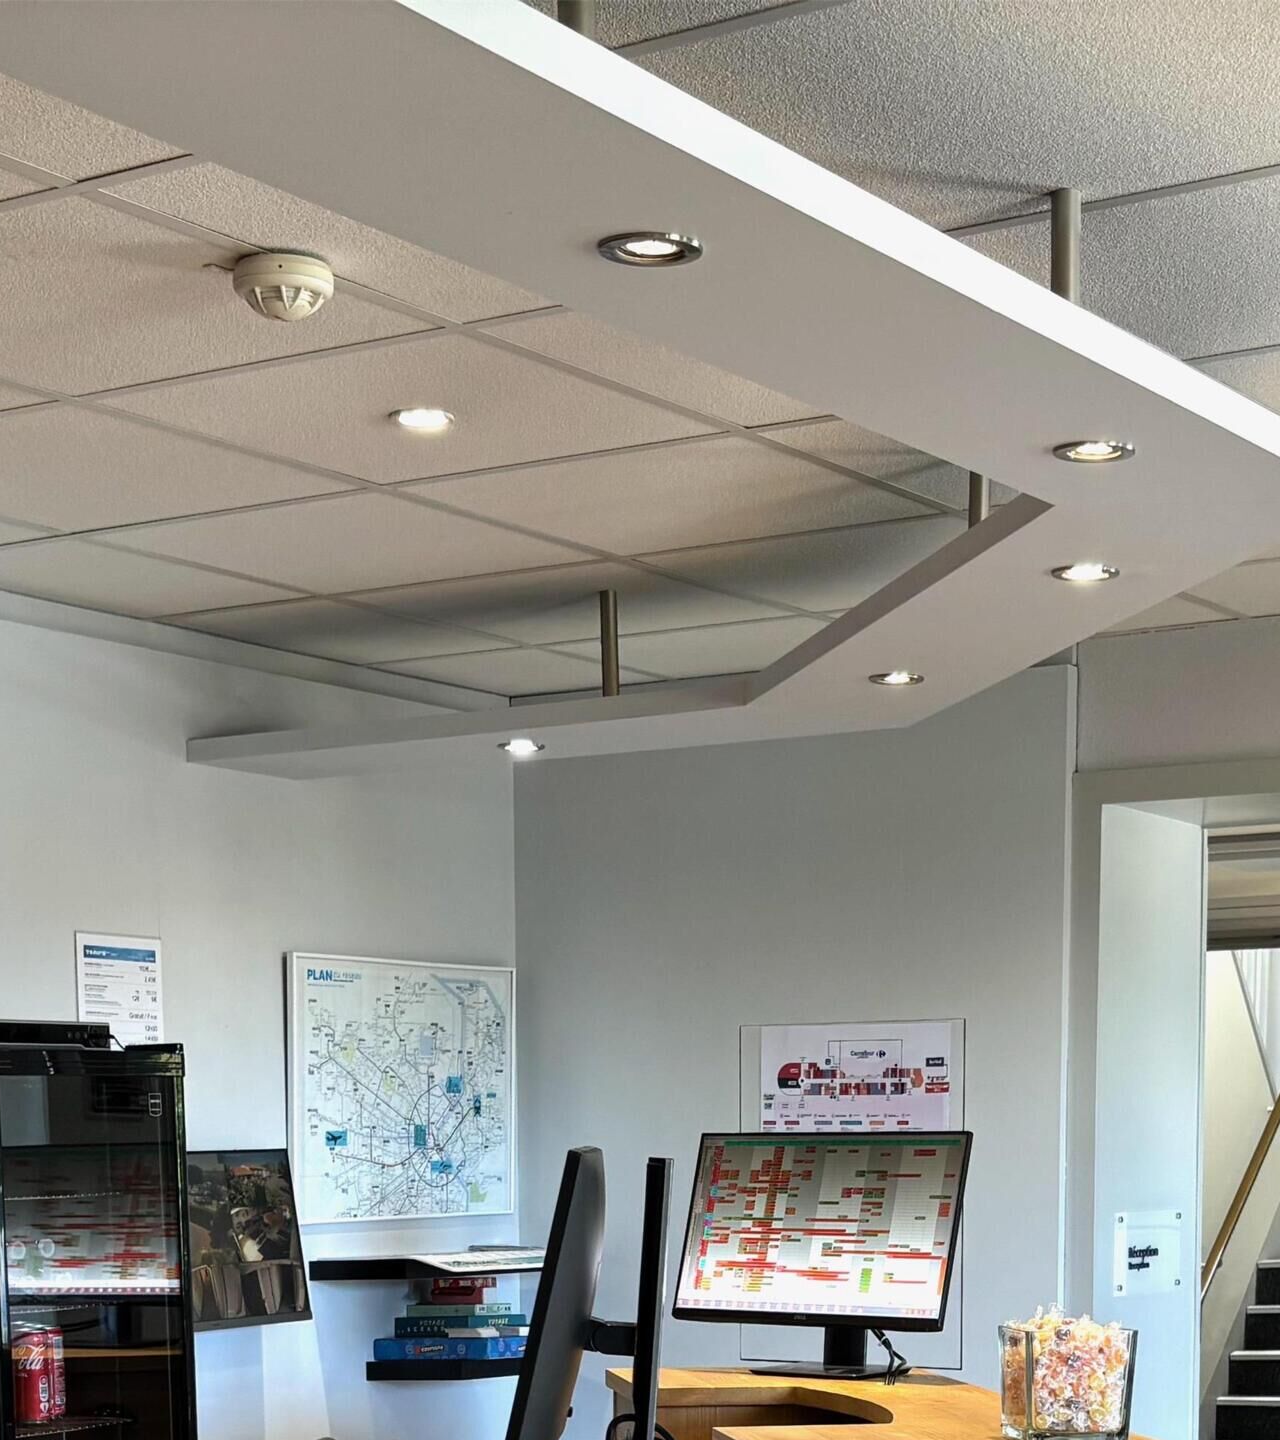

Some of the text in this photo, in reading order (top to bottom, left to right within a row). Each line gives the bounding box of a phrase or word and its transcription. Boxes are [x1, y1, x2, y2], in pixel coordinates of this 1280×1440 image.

[306, 968, 333, 982] PLAN
[850, 1049, 875, 1057] Carrefour
[1128, 1244, 1159, 1263] Réception
